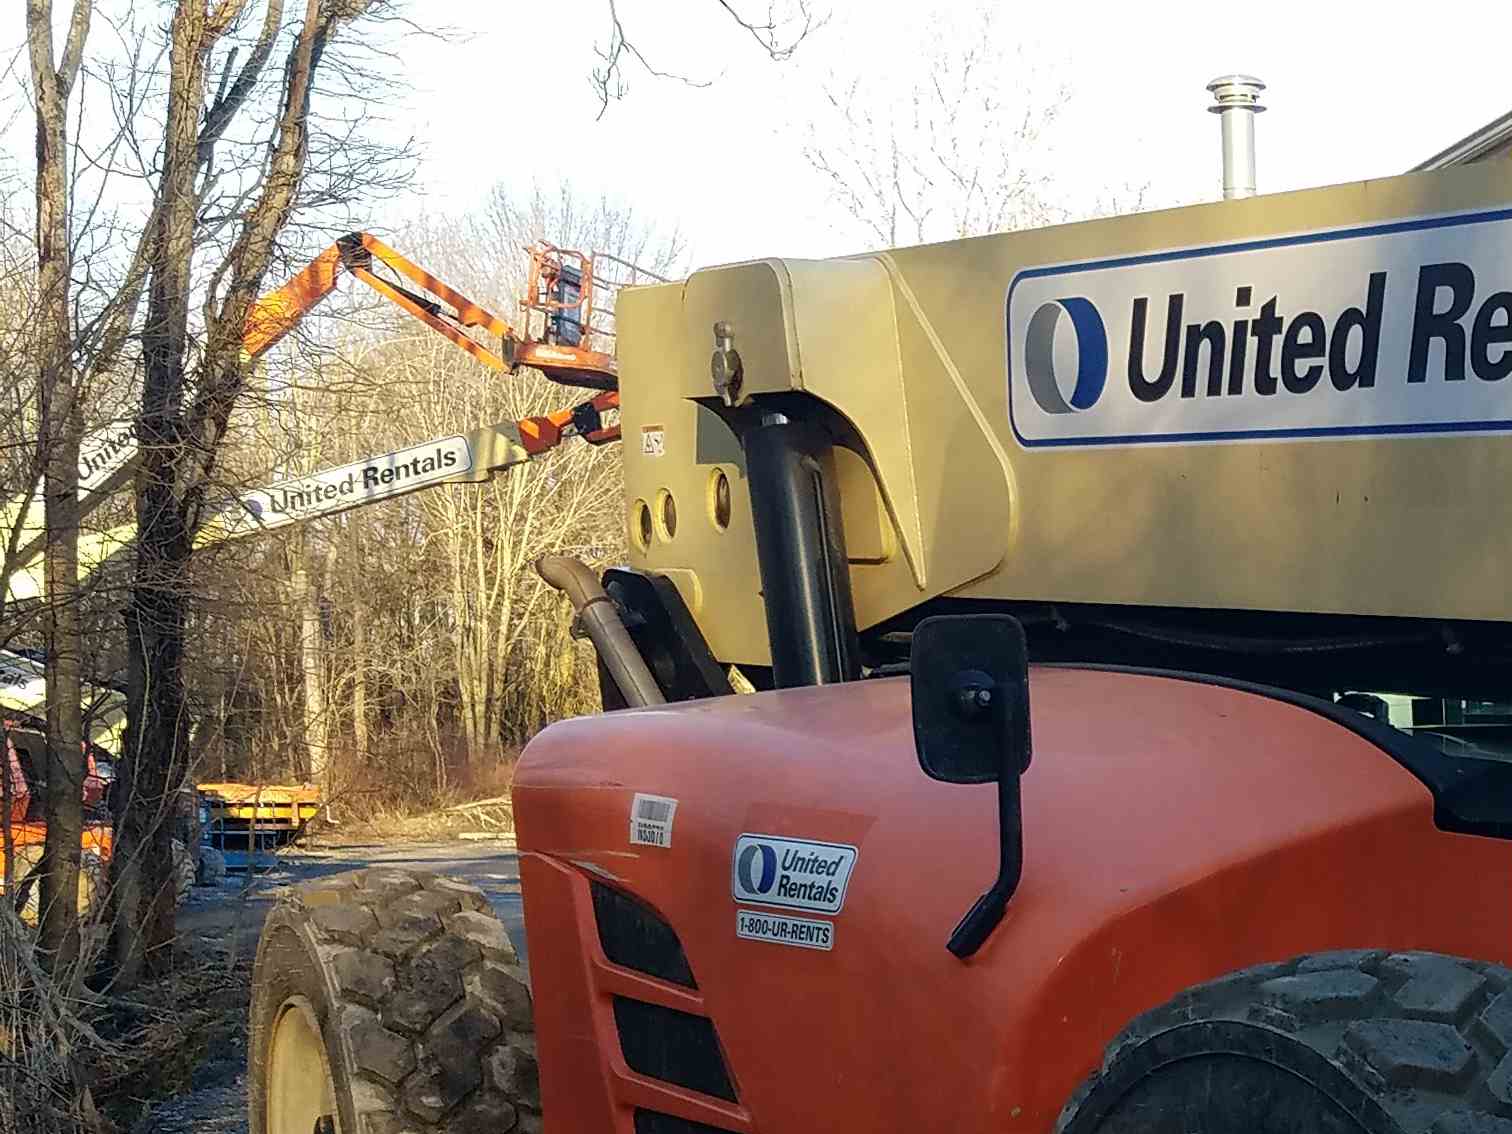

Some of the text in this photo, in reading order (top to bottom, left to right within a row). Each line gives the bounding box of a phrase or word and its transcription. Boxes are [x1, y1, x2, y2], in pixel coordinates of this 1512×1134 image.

[1126, 271, 1389, 403] United
[270, 448, 457, 513] United Rentals
[781, 848, 844, 877] United
[777, 874, 840, 904] Rentals
[739, 916, 830, 944] 1-800-UR-RENTS
